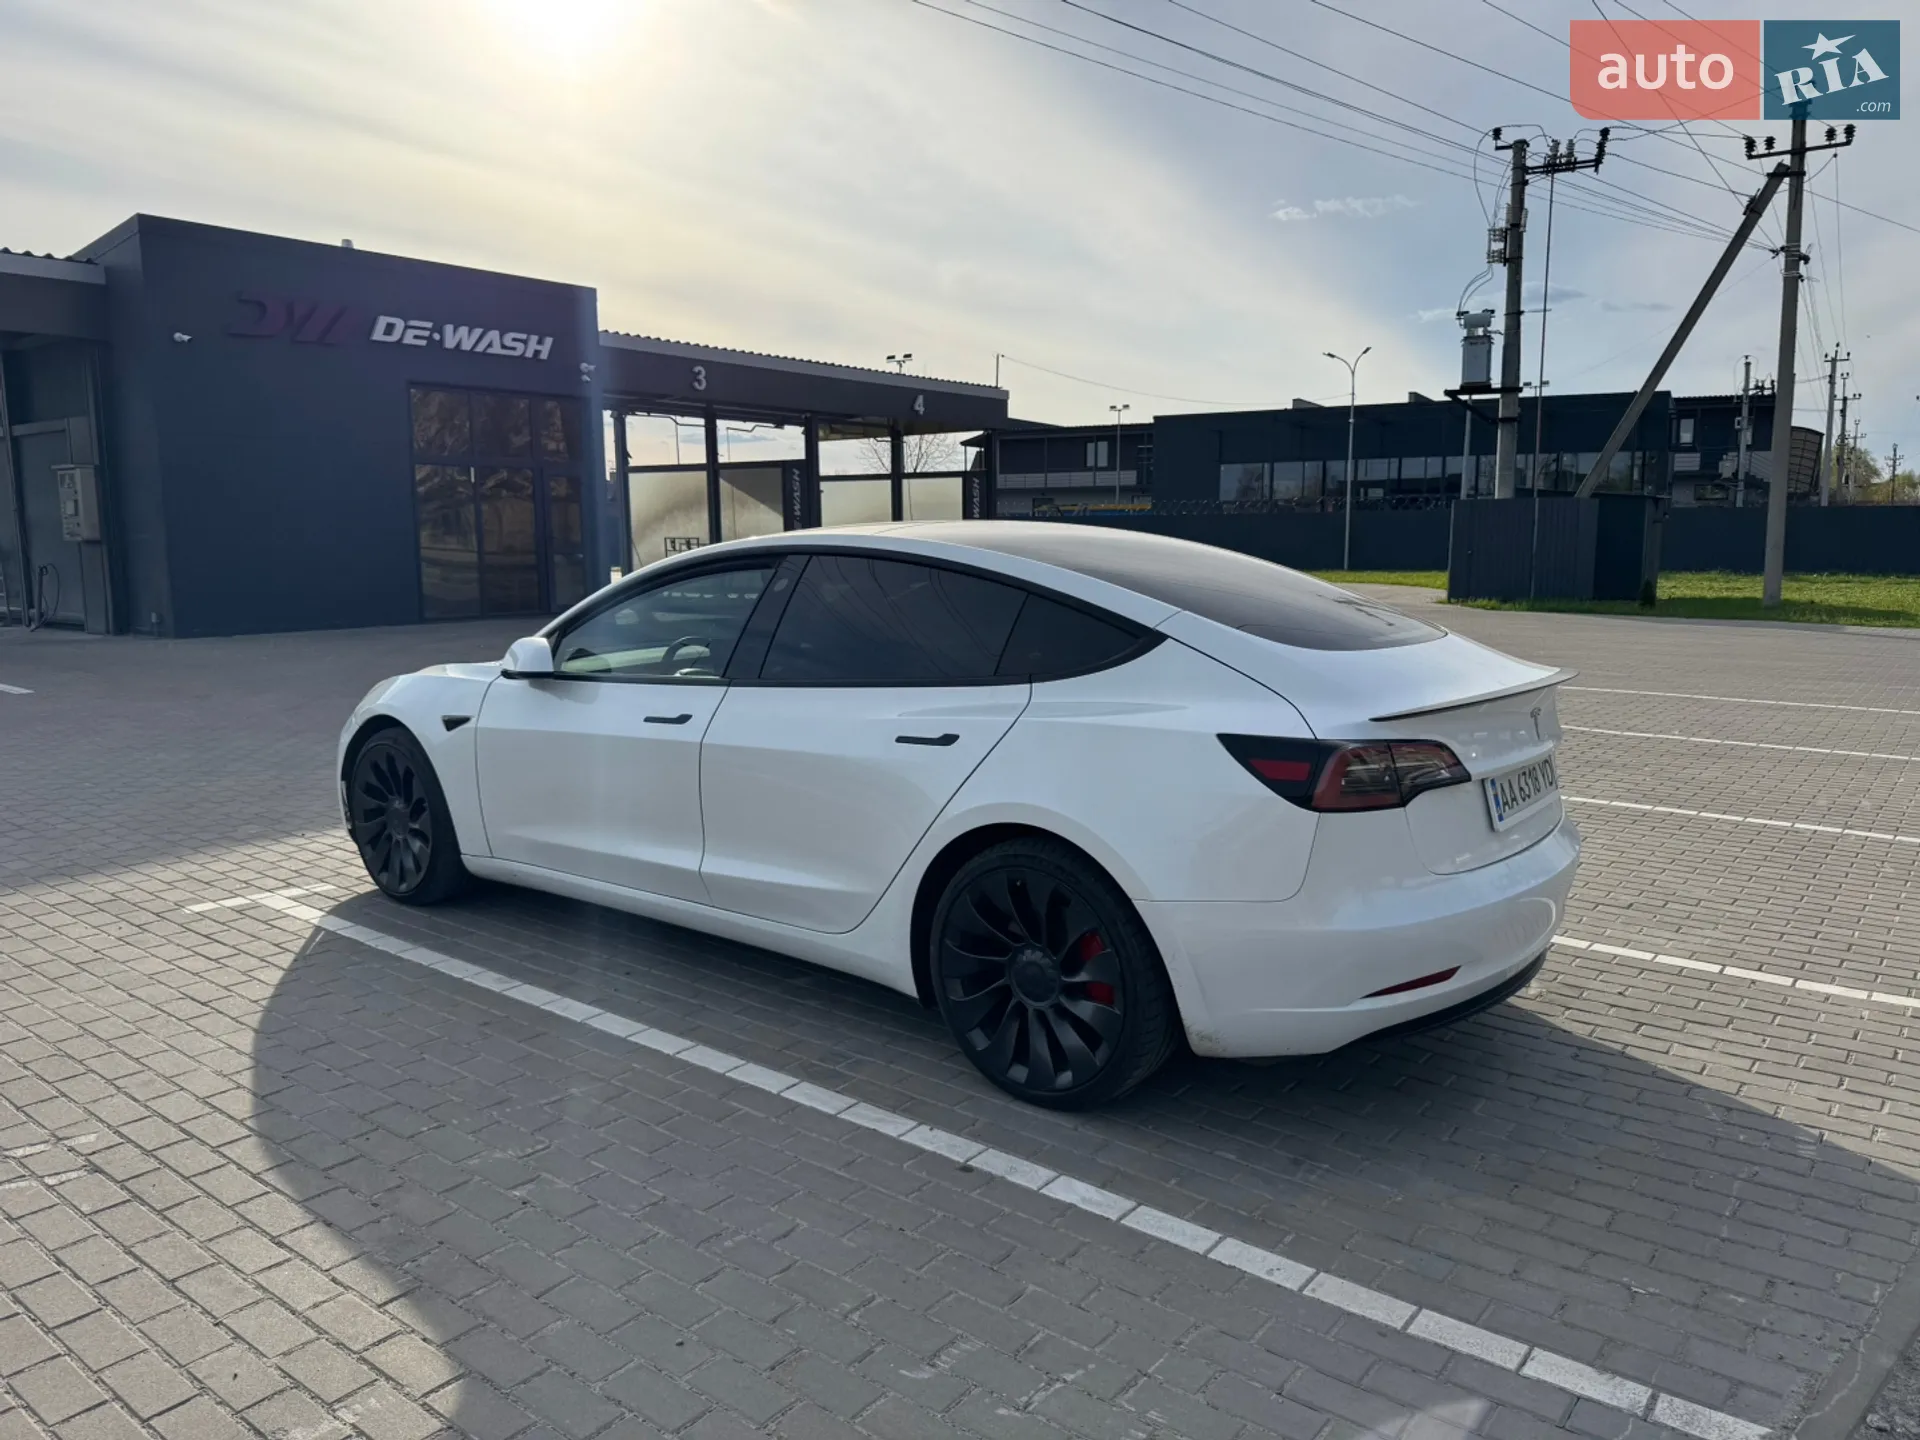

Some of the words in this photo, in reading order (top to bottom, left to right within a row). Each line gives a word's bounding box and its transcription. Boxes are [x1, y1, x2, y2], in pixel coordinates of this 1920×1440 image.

[692, 365, 707, 390] 3
[914, 394, 925, 415] 4
[1500, 779, 1519, 813] AA
[1518, 766, 1541, 802] 6318
